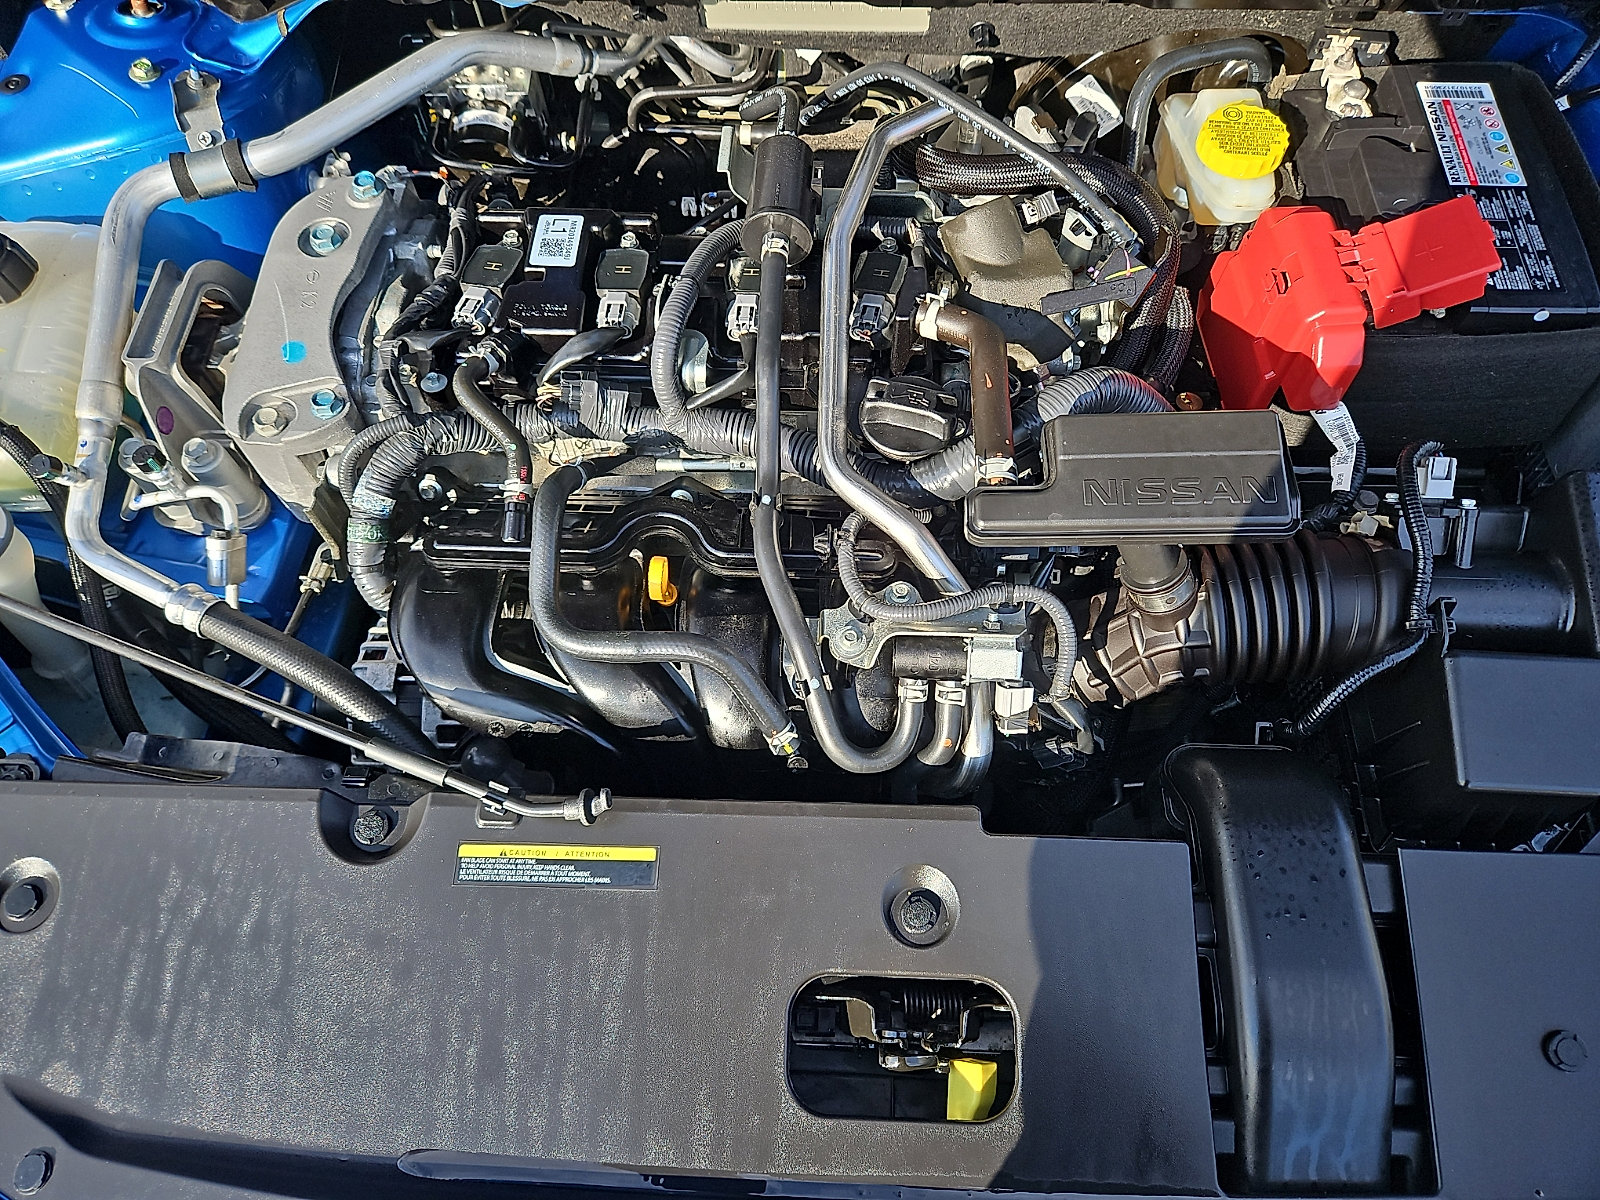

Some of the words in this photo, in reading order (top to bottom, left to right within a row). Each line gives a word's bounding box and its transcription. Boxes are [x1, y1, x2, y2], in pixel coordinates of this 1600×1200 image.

[1426, 102, 1449, 142] NISSAN
[1440, 145, 1461, 182] RENAULT
[551, 219, 570, 232] L1
[1082, 475, 1278, 506] NISSAN
